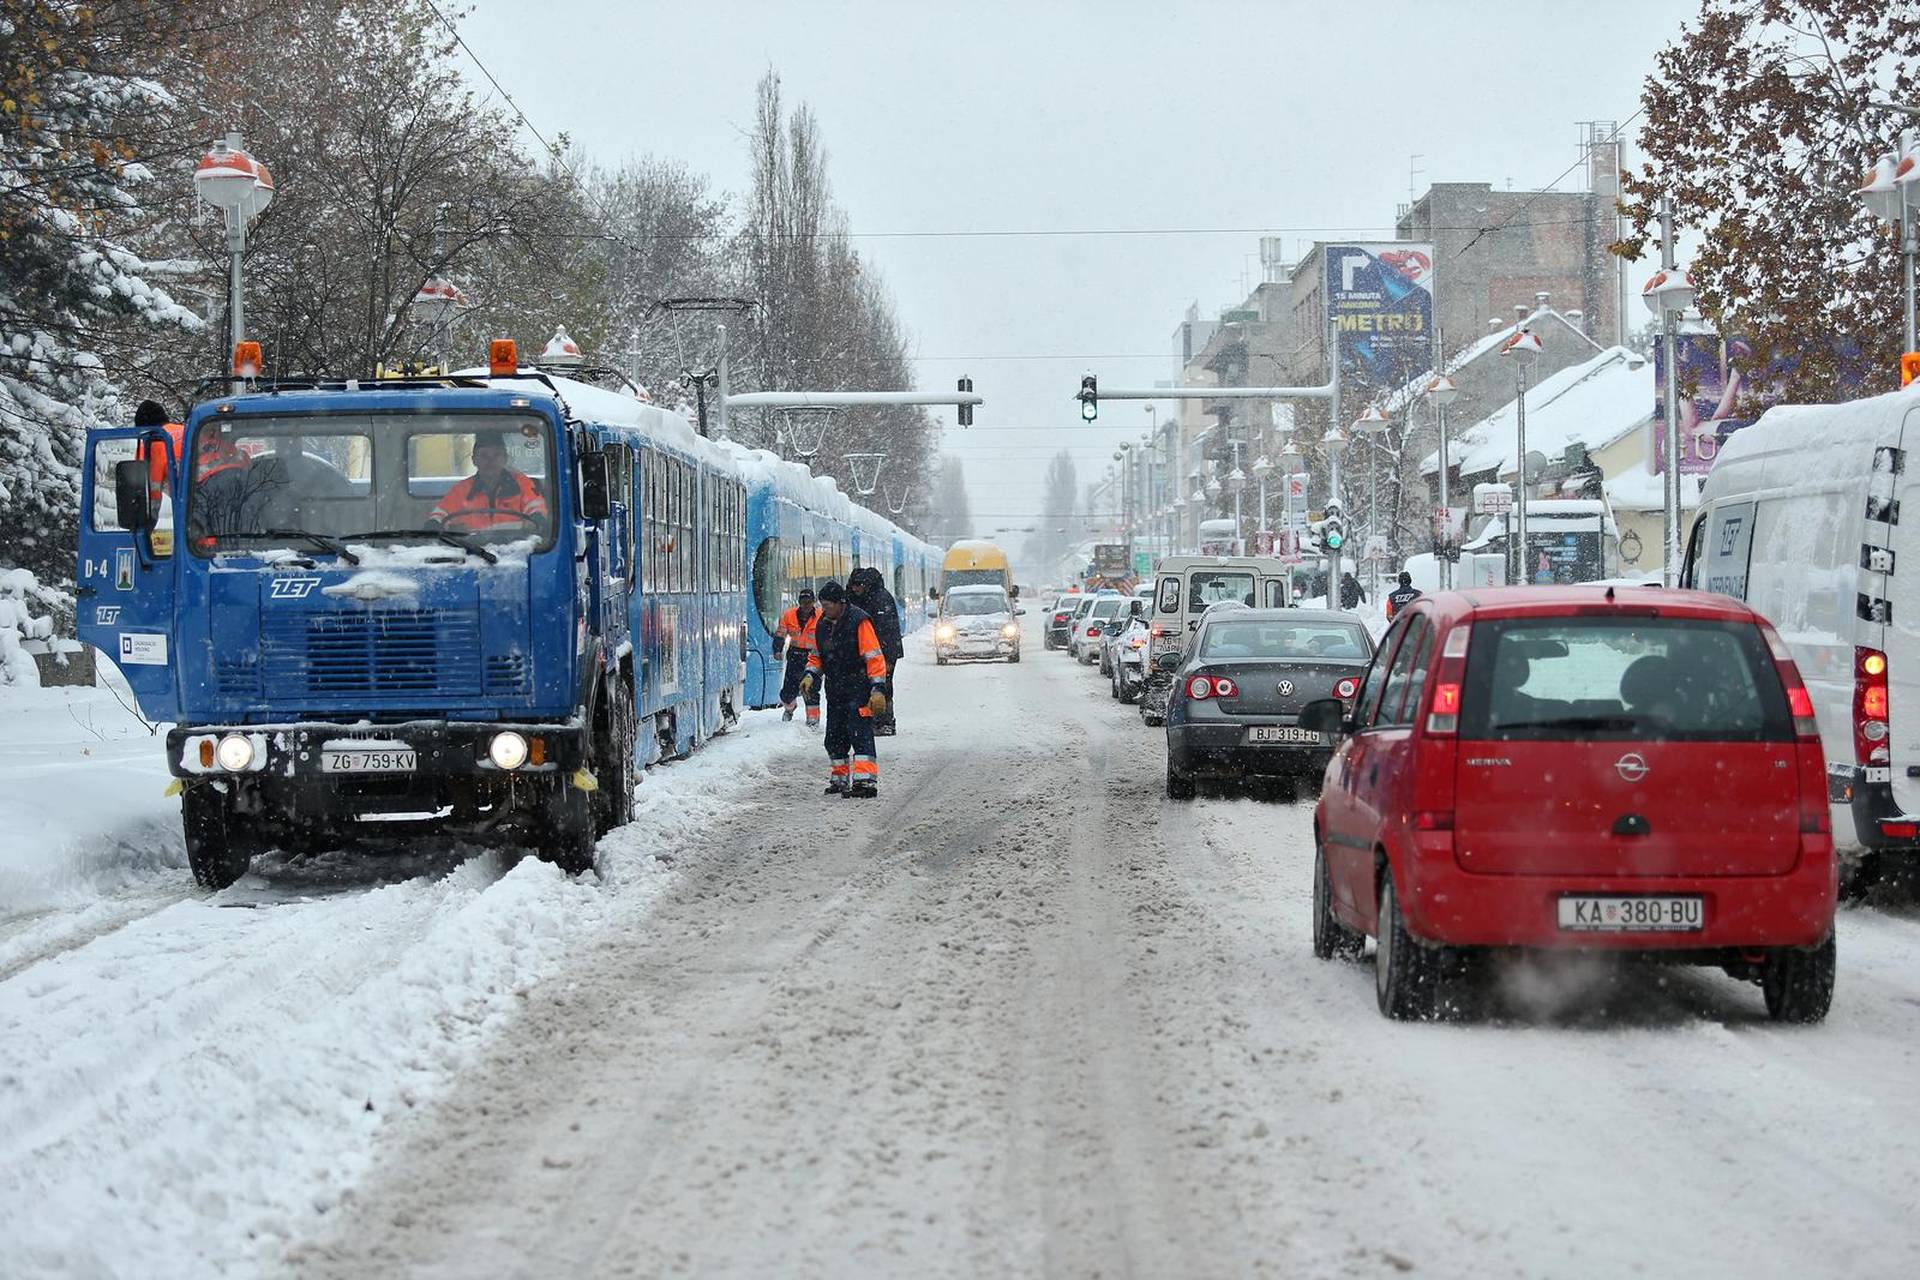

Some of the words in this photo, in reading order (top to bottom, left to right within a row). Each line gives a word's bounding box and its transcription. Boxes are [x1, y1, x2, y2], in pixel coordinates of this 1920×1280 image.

[1348, 292, 1380, 300] MINUTA
[1337, 313, 1423, 332] METRO
[270, 577, 322, 598] ZET
[96, 606, 122, 625] ZET
[1257, 729, 1271, 740] BJ
[1278, 729, 1318, 741] 319-FG
[332, 754, 351, 770] ZG
[362, 754, 415, 769] 759-KV
[1575, 901, 1602, 922] KA
[1620, 901, 1698, 923] 380-BU
